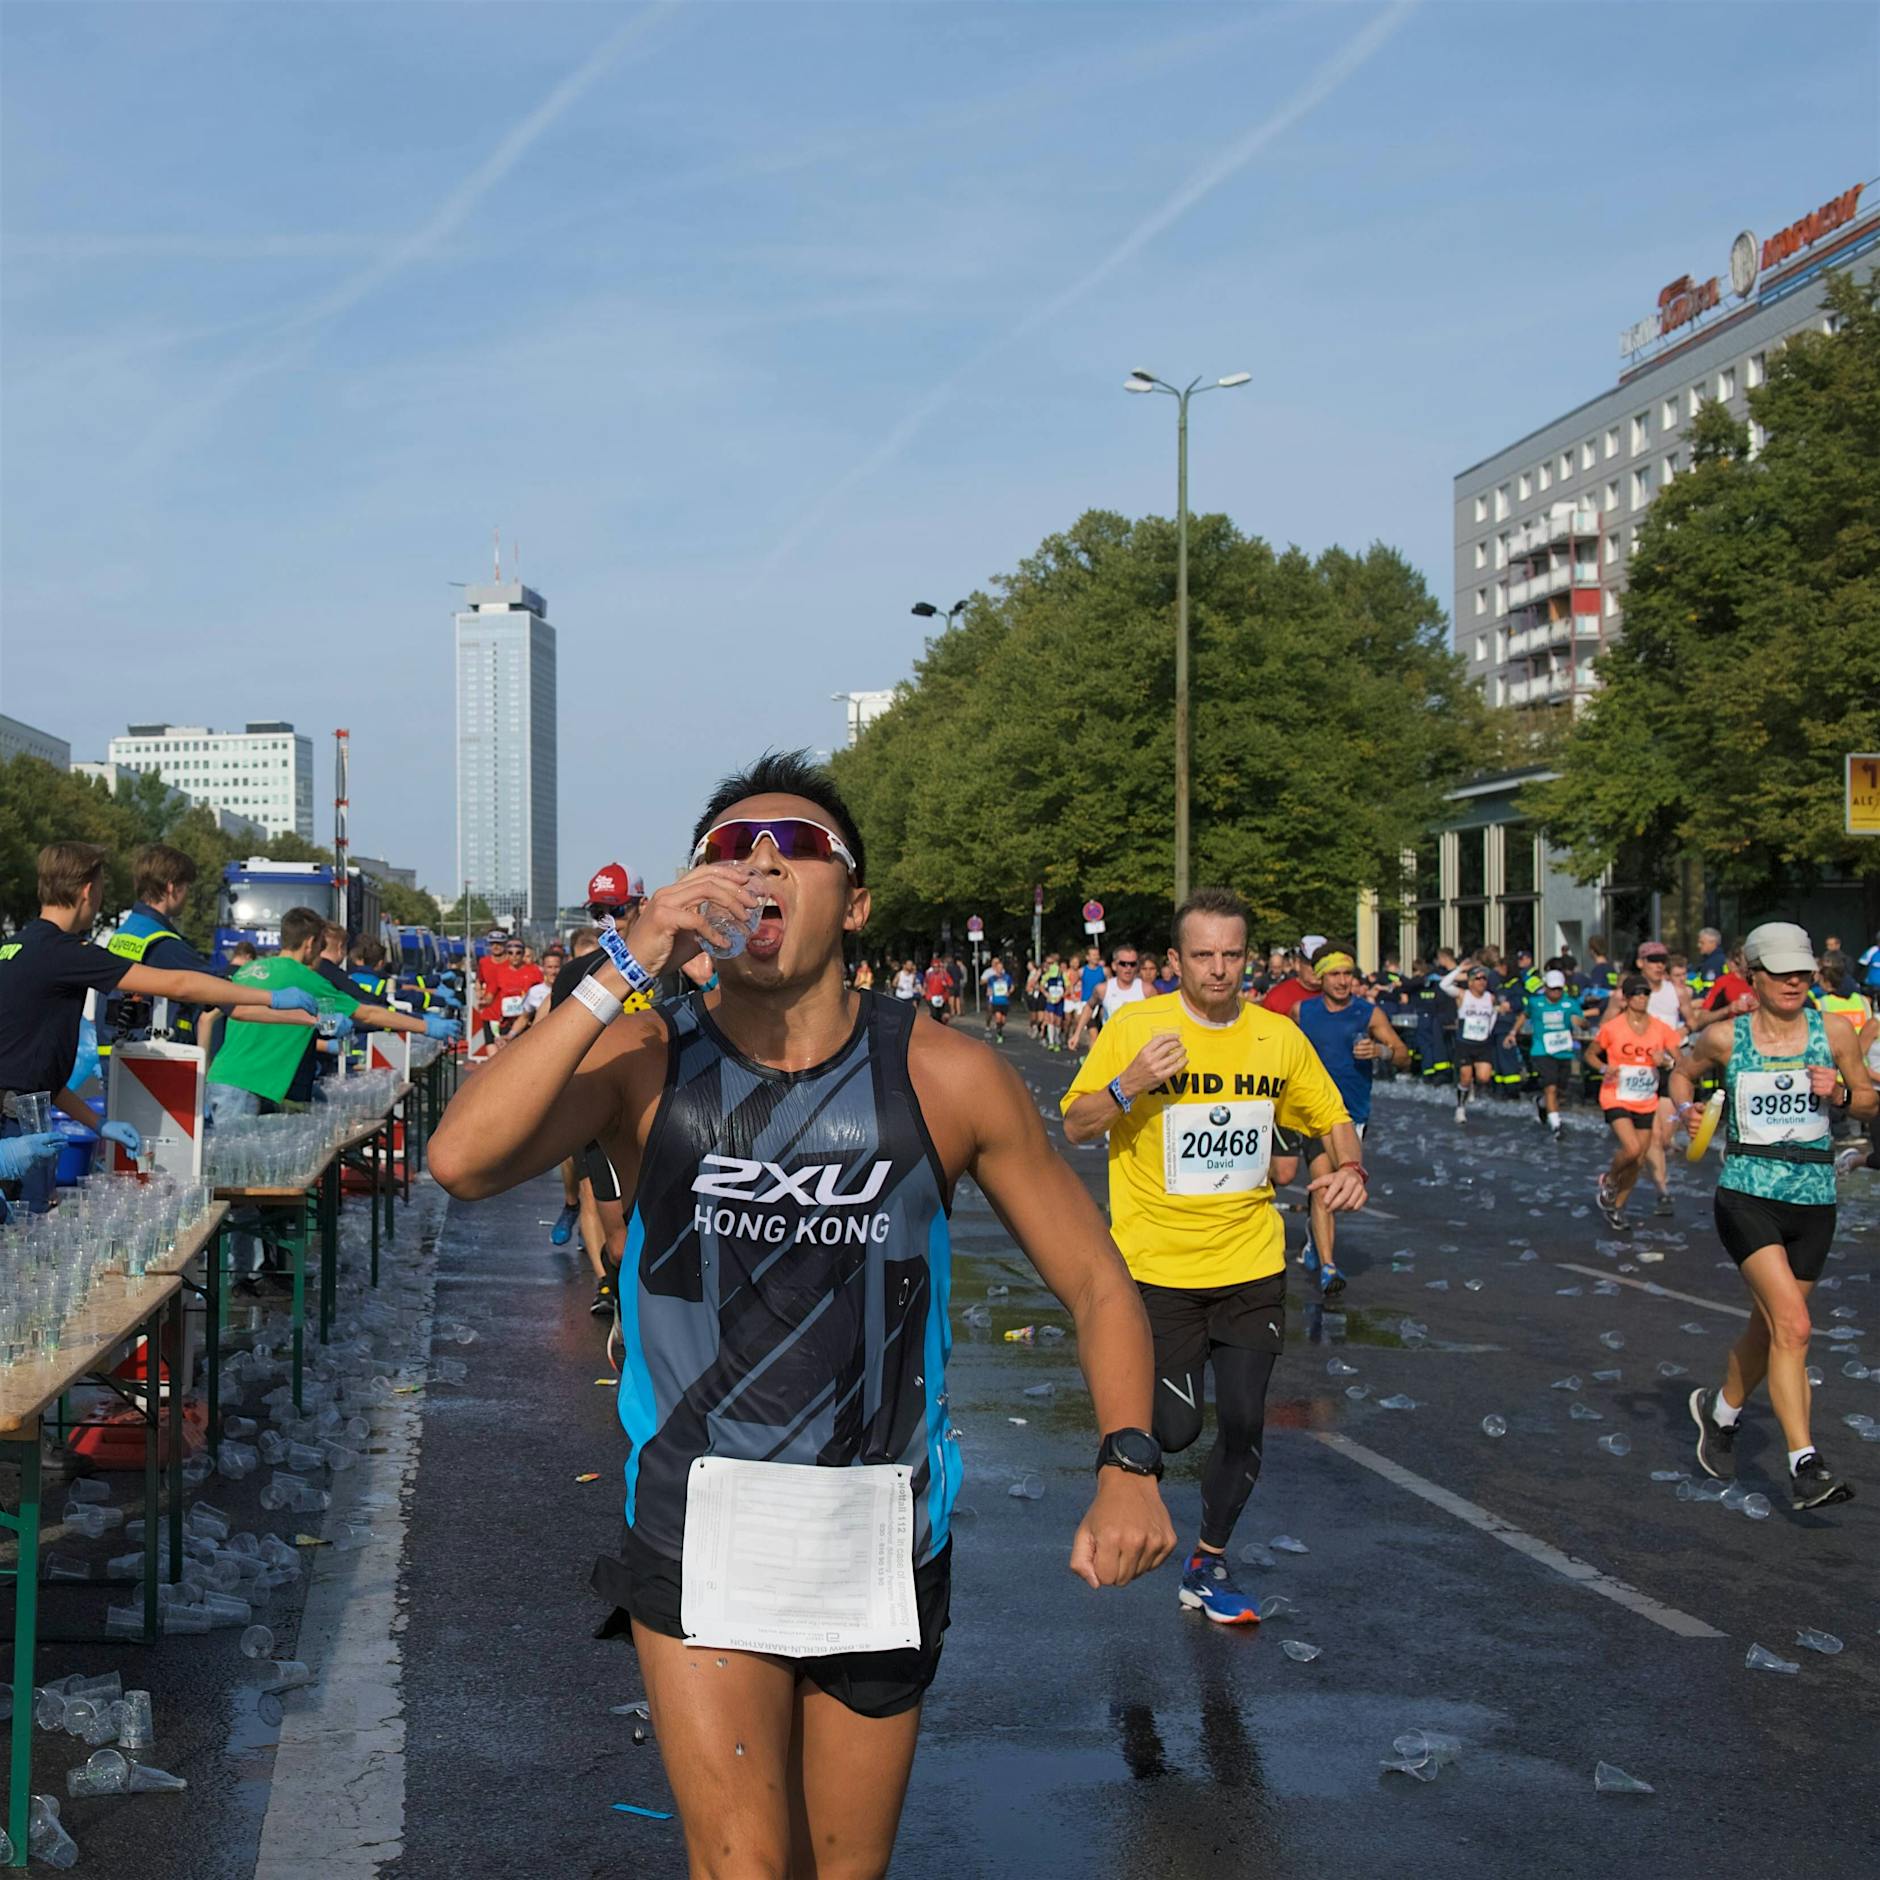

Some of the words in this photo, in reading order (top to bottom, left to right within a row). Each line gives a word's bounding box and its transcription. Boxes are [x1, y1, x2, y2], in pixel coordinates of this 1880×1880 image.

[1750, 1092, 1820, 1115] 39859
[1766, 1116, 1806, 1125] Christine
[1181, 1129, 1259, 1159] 20468
[1207, 1159, 1234, 1169] David
[690, 1153, 893, 1206] 2XU
[693, 1204, 786, 1243] HONG
[794, 1212, 890, 1245] KONG
[897, 1516, 906, 1534] 112
